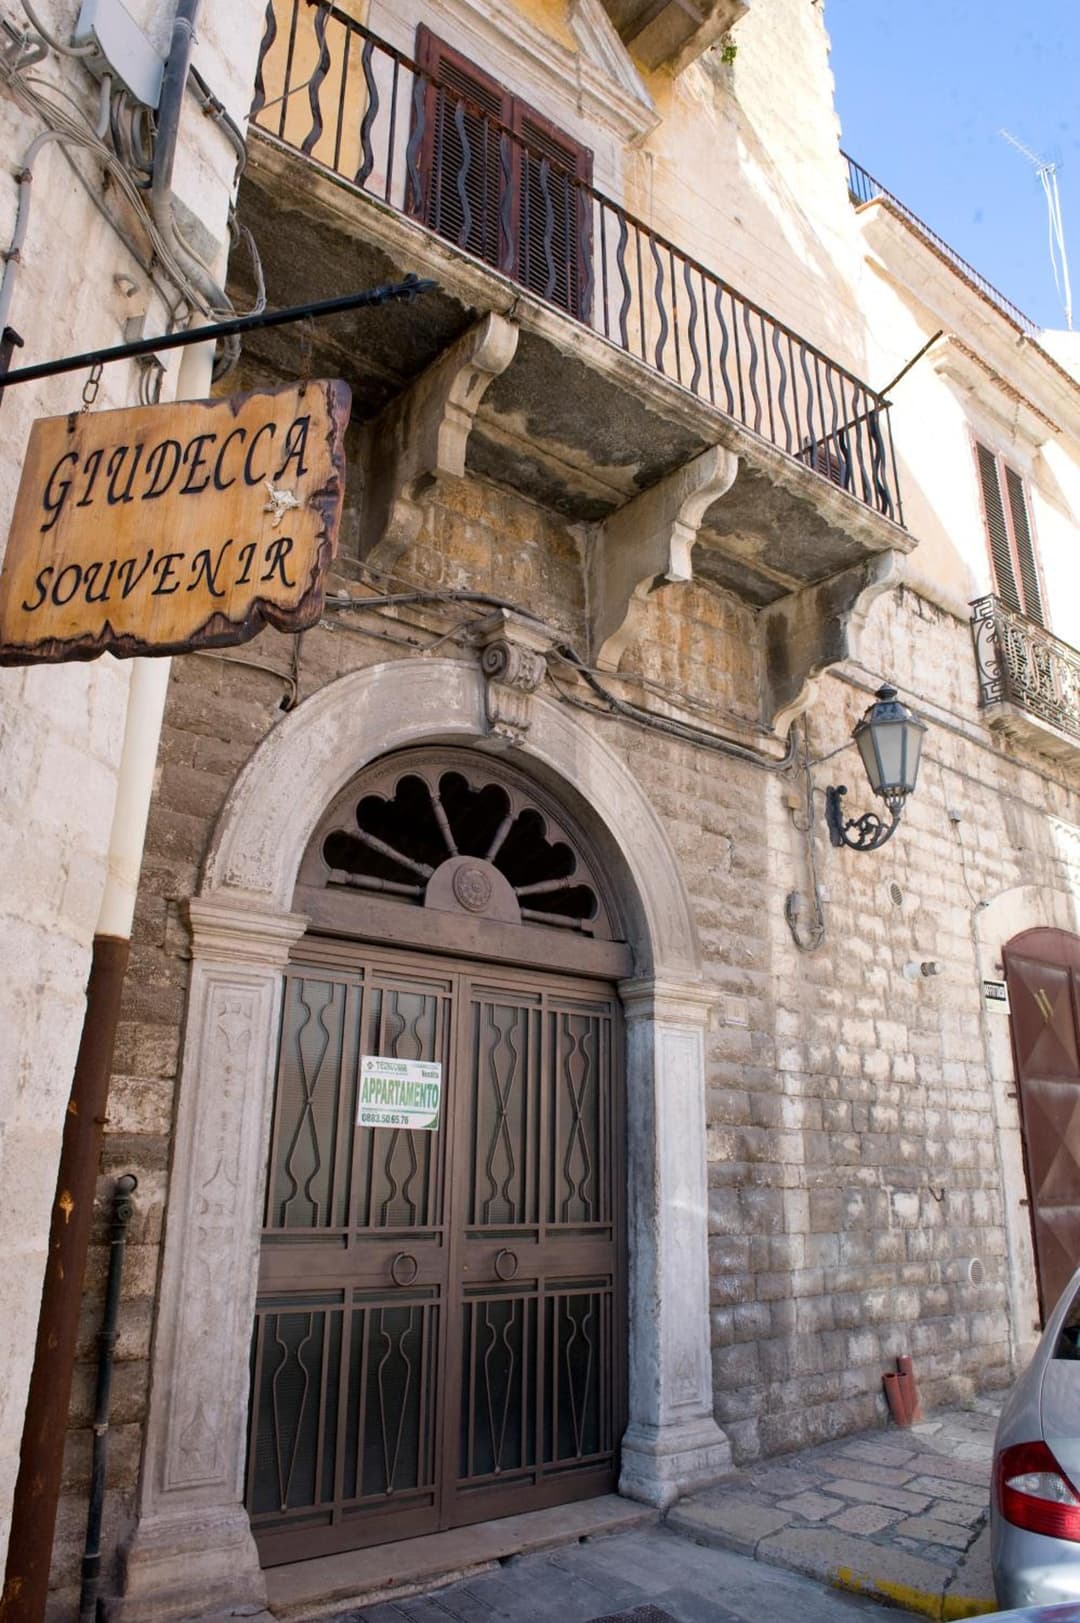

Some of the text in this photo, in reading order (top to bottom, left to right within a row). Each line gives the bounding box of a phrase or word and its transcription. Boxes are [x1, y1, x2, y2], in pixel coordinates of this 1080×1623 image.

[40, 415, 311, 532] GIUDECCA
[22, 537, 296, 612] SOUVENIR
[361, 1077, 440, 1109] APPARTAMENTO
